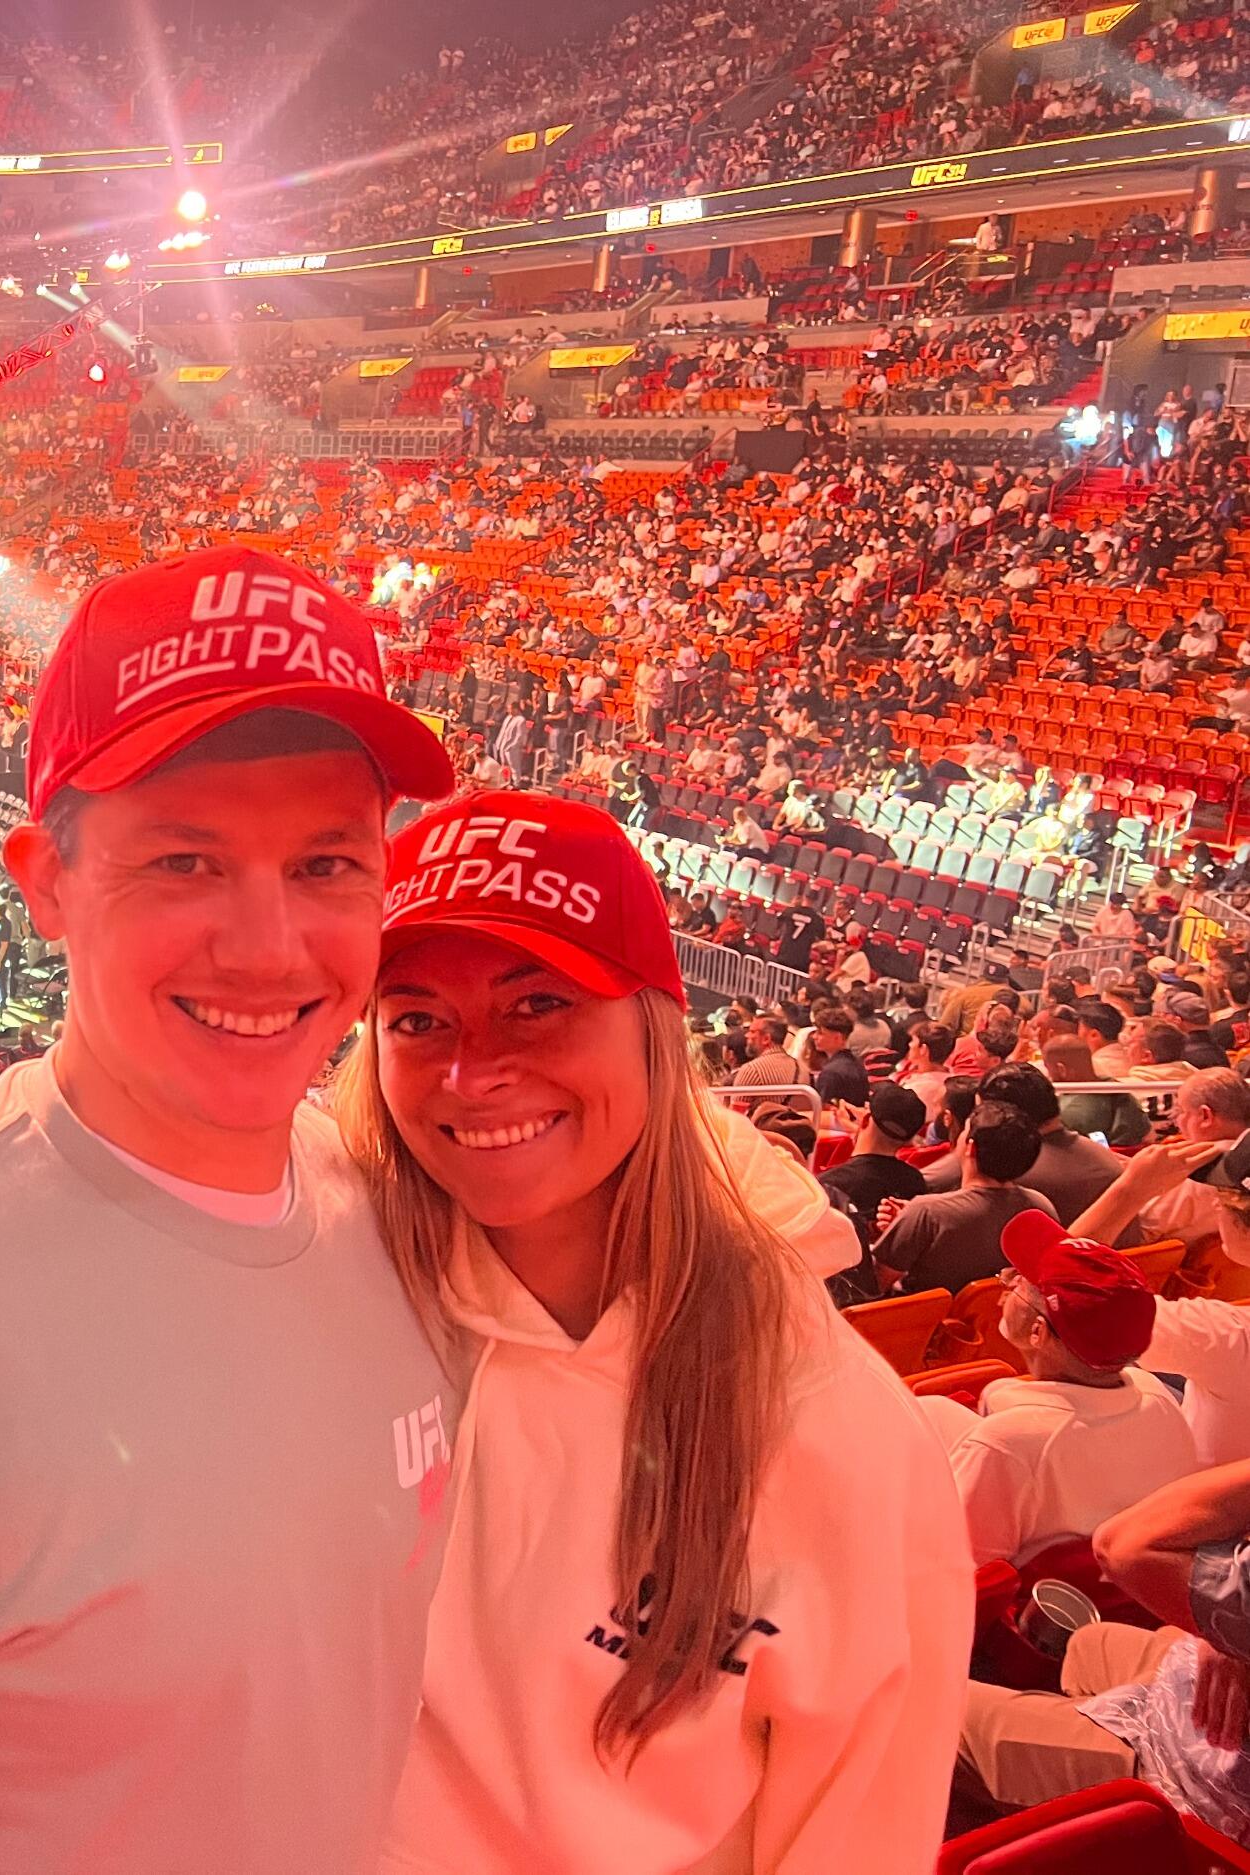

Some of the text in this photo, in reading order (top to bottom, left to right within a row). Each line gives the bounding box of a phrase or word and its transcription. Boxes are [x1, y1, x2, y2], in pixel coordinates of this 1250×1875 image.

[190, 570, 327, 633] UFC
[417, 815, 548, 866] UFC
[792, 912, 812, 940] 7
